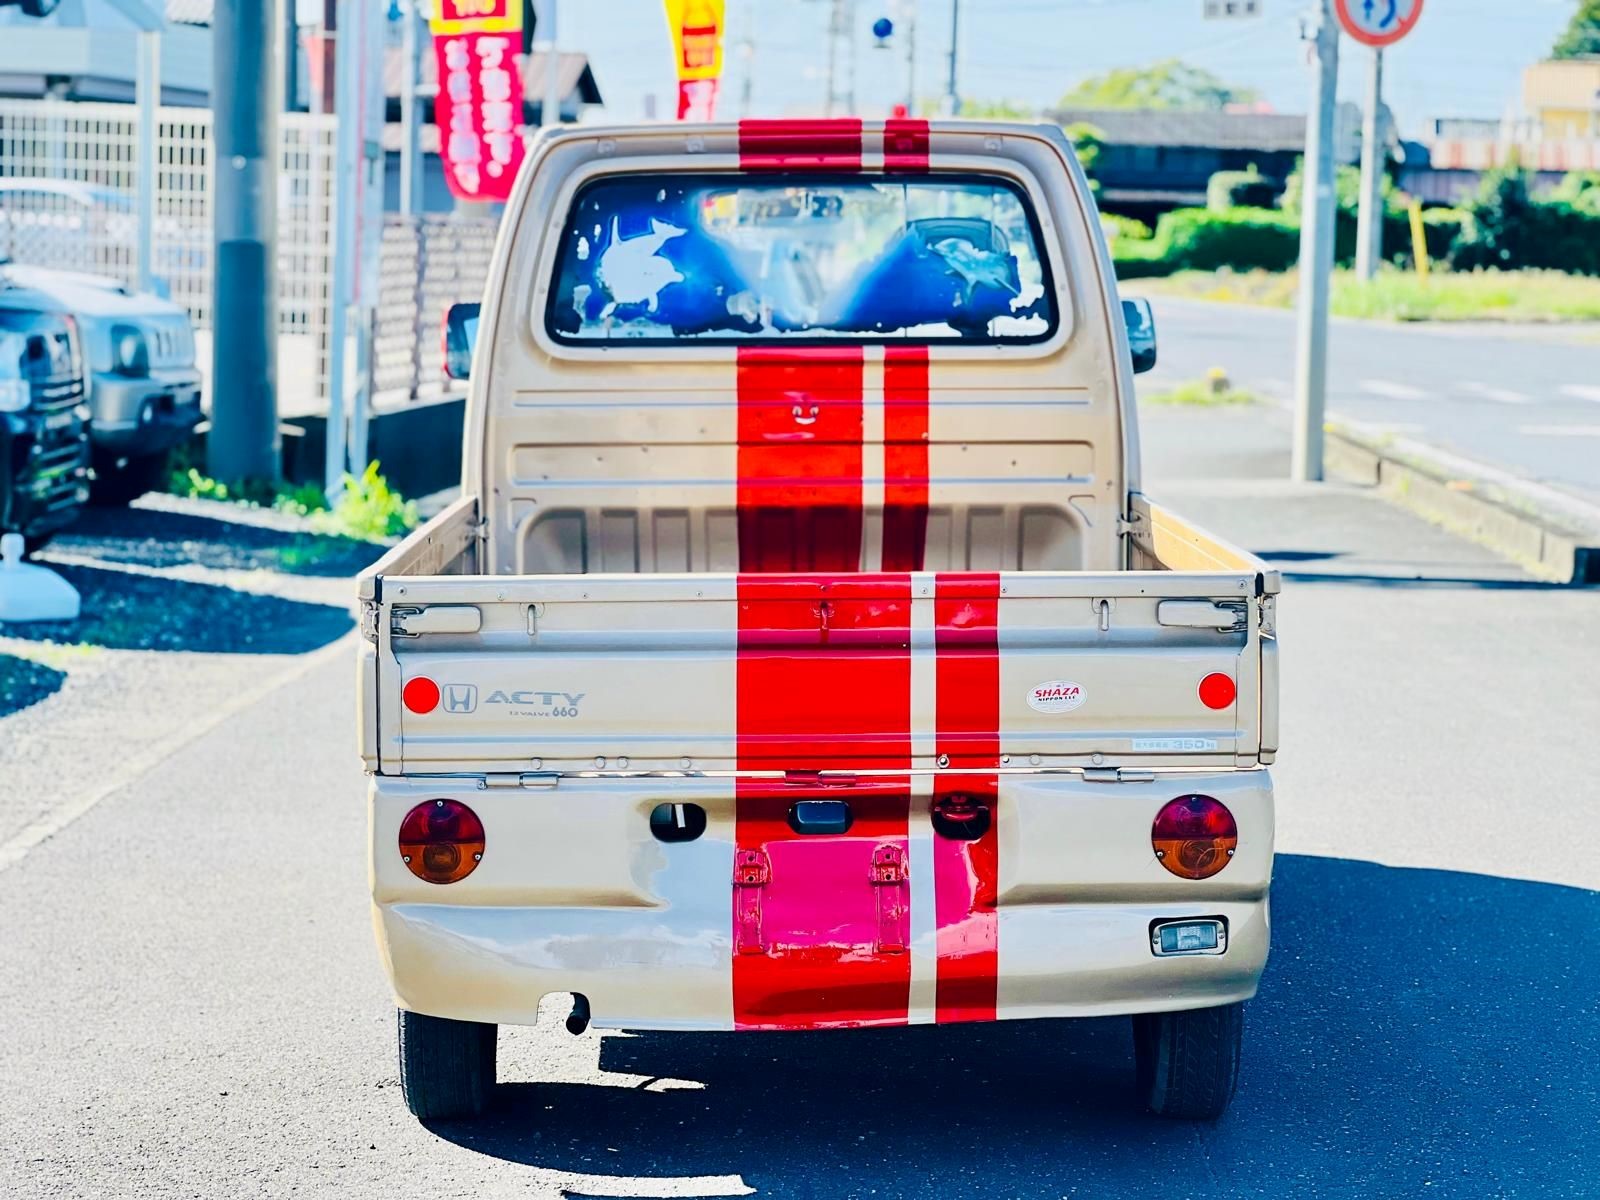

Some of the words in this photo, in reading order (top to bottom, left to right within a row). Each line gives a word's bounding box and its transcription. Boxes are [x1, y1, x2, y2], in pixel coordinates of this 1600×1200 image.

[1035, 687, 1080, 697] SHAZA
[484, 690, 586, 706] ACTY
[552, 707, 578, 717] 660
[1173, 740, 1205, 749] 350
